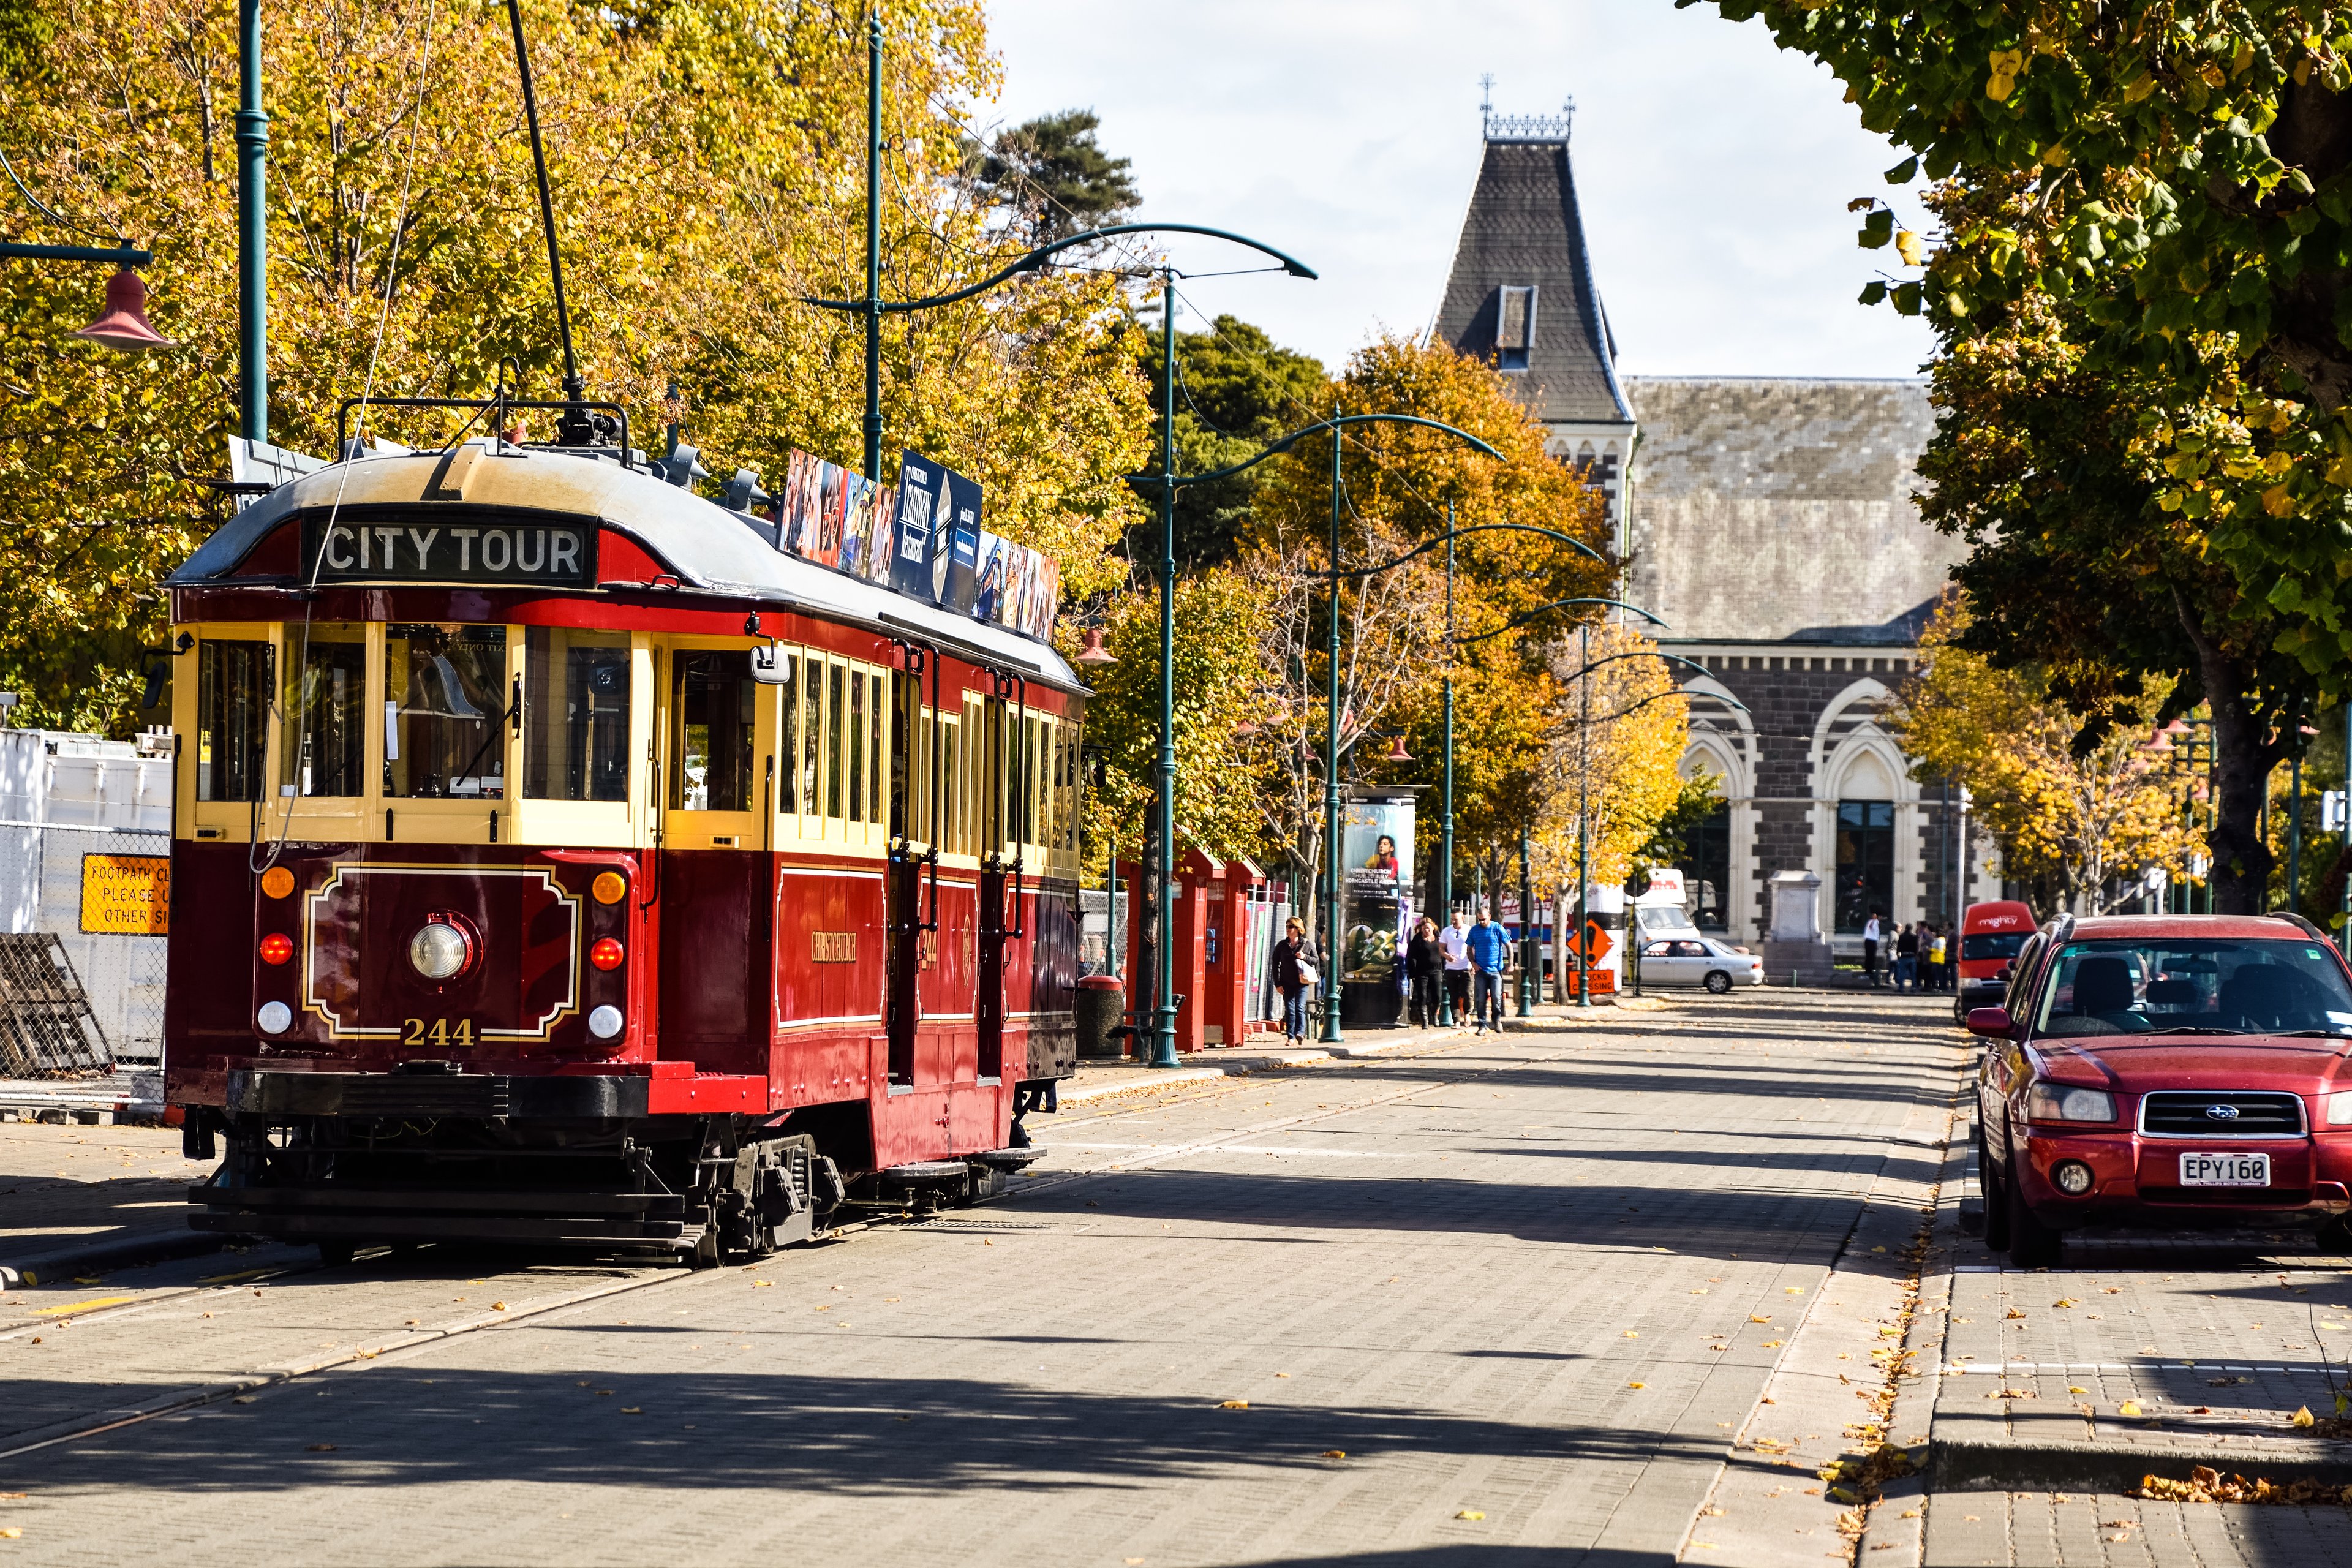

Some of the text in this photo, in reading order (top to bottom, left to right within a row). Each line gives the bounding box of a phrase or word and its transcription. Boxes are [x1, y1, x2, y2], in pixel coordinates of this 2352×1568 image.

[903, 465, 932, 545] Tramway
[326, 526, 580, 573] CITY TOUR
[900, 524, 924, 564] Restaurant
[92, 865, 151, 880] FOOTPATH
[103, 888, 154, 902] PLEASE
[105, 909, 147, 923] OTHER
[1979, 916, 2018, 927] mighty
[812, 931, 856, 962] CHRISTCHURCH
[1572, 982, 1613, 990] CSSING
[404, 1018, 475, 1046] 244
[2186, 1159, 2264, 1180] EPY160
